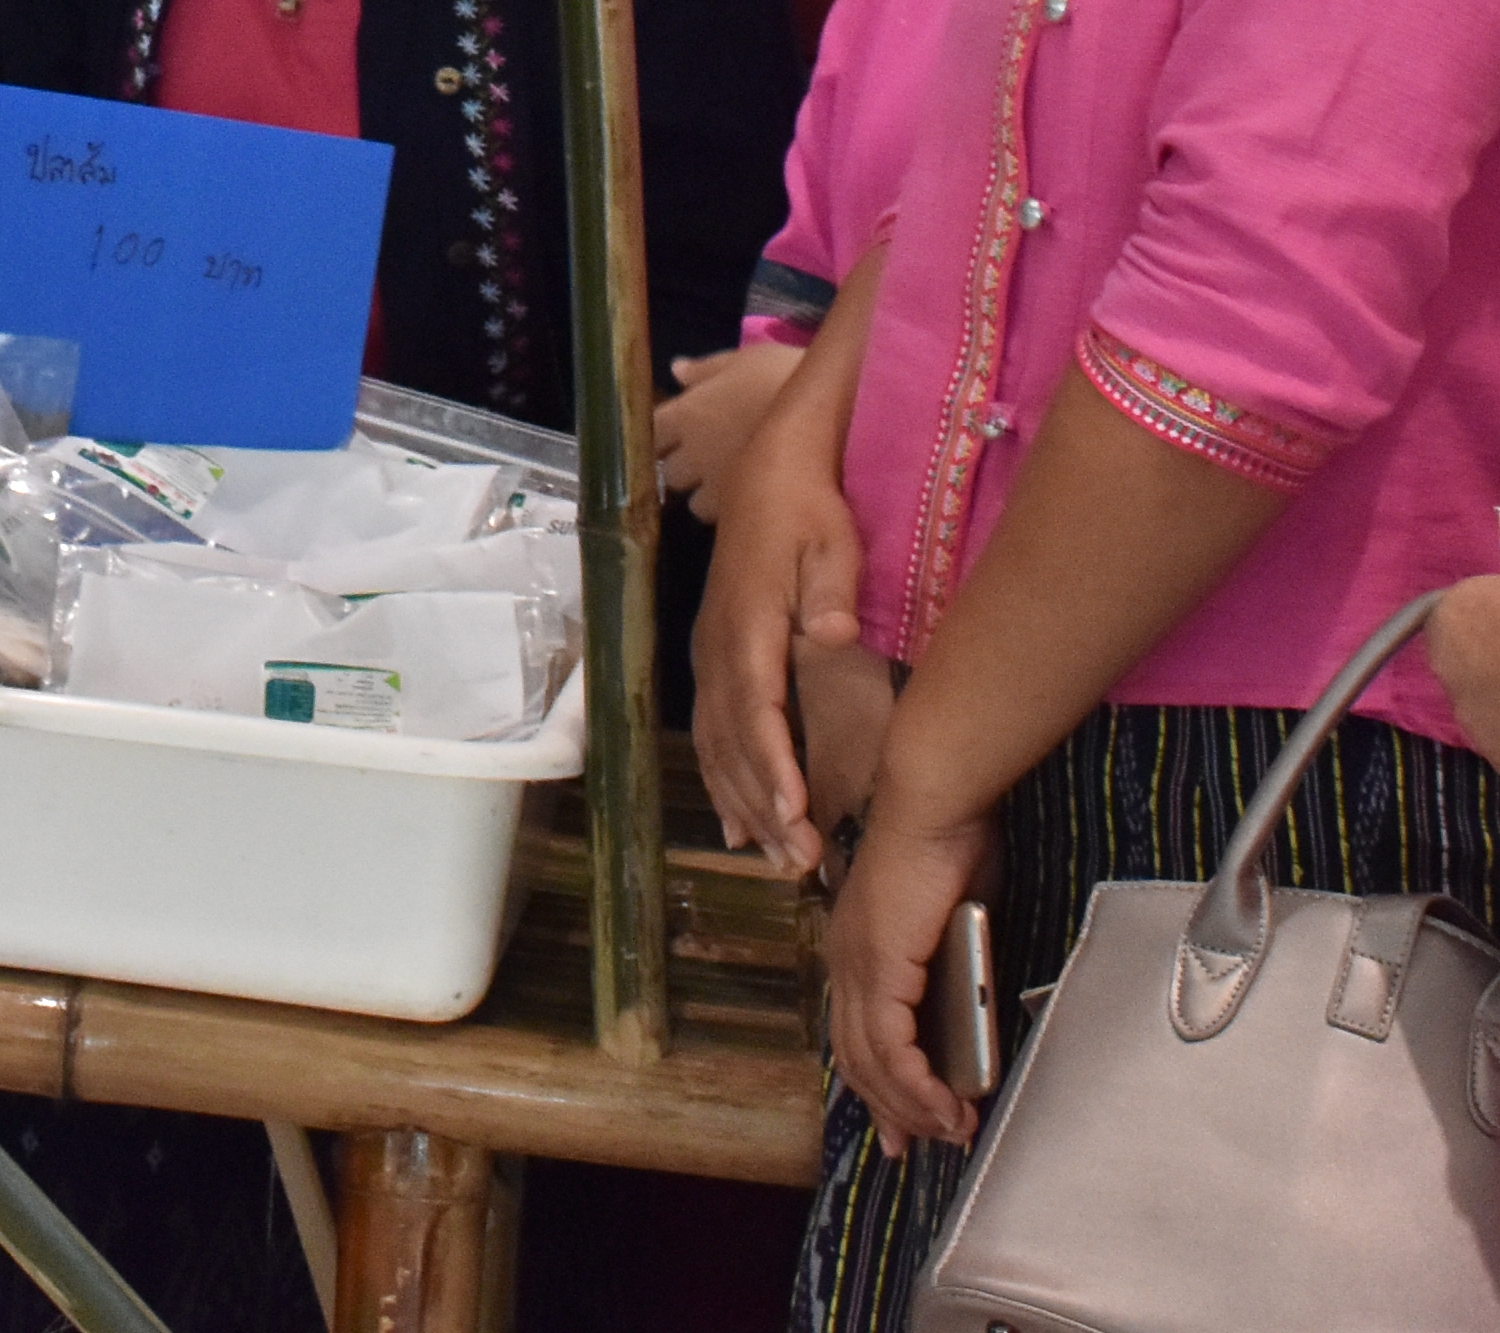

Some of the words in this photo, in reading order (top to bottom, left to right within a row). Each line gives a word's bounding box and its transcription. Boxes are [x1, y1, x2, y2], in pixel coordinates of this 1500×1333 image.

[26, 134, 117, 185] ปลาส้ม
[90, 224, 165, 271] 100
[203, 253, 263, 289] บาท
